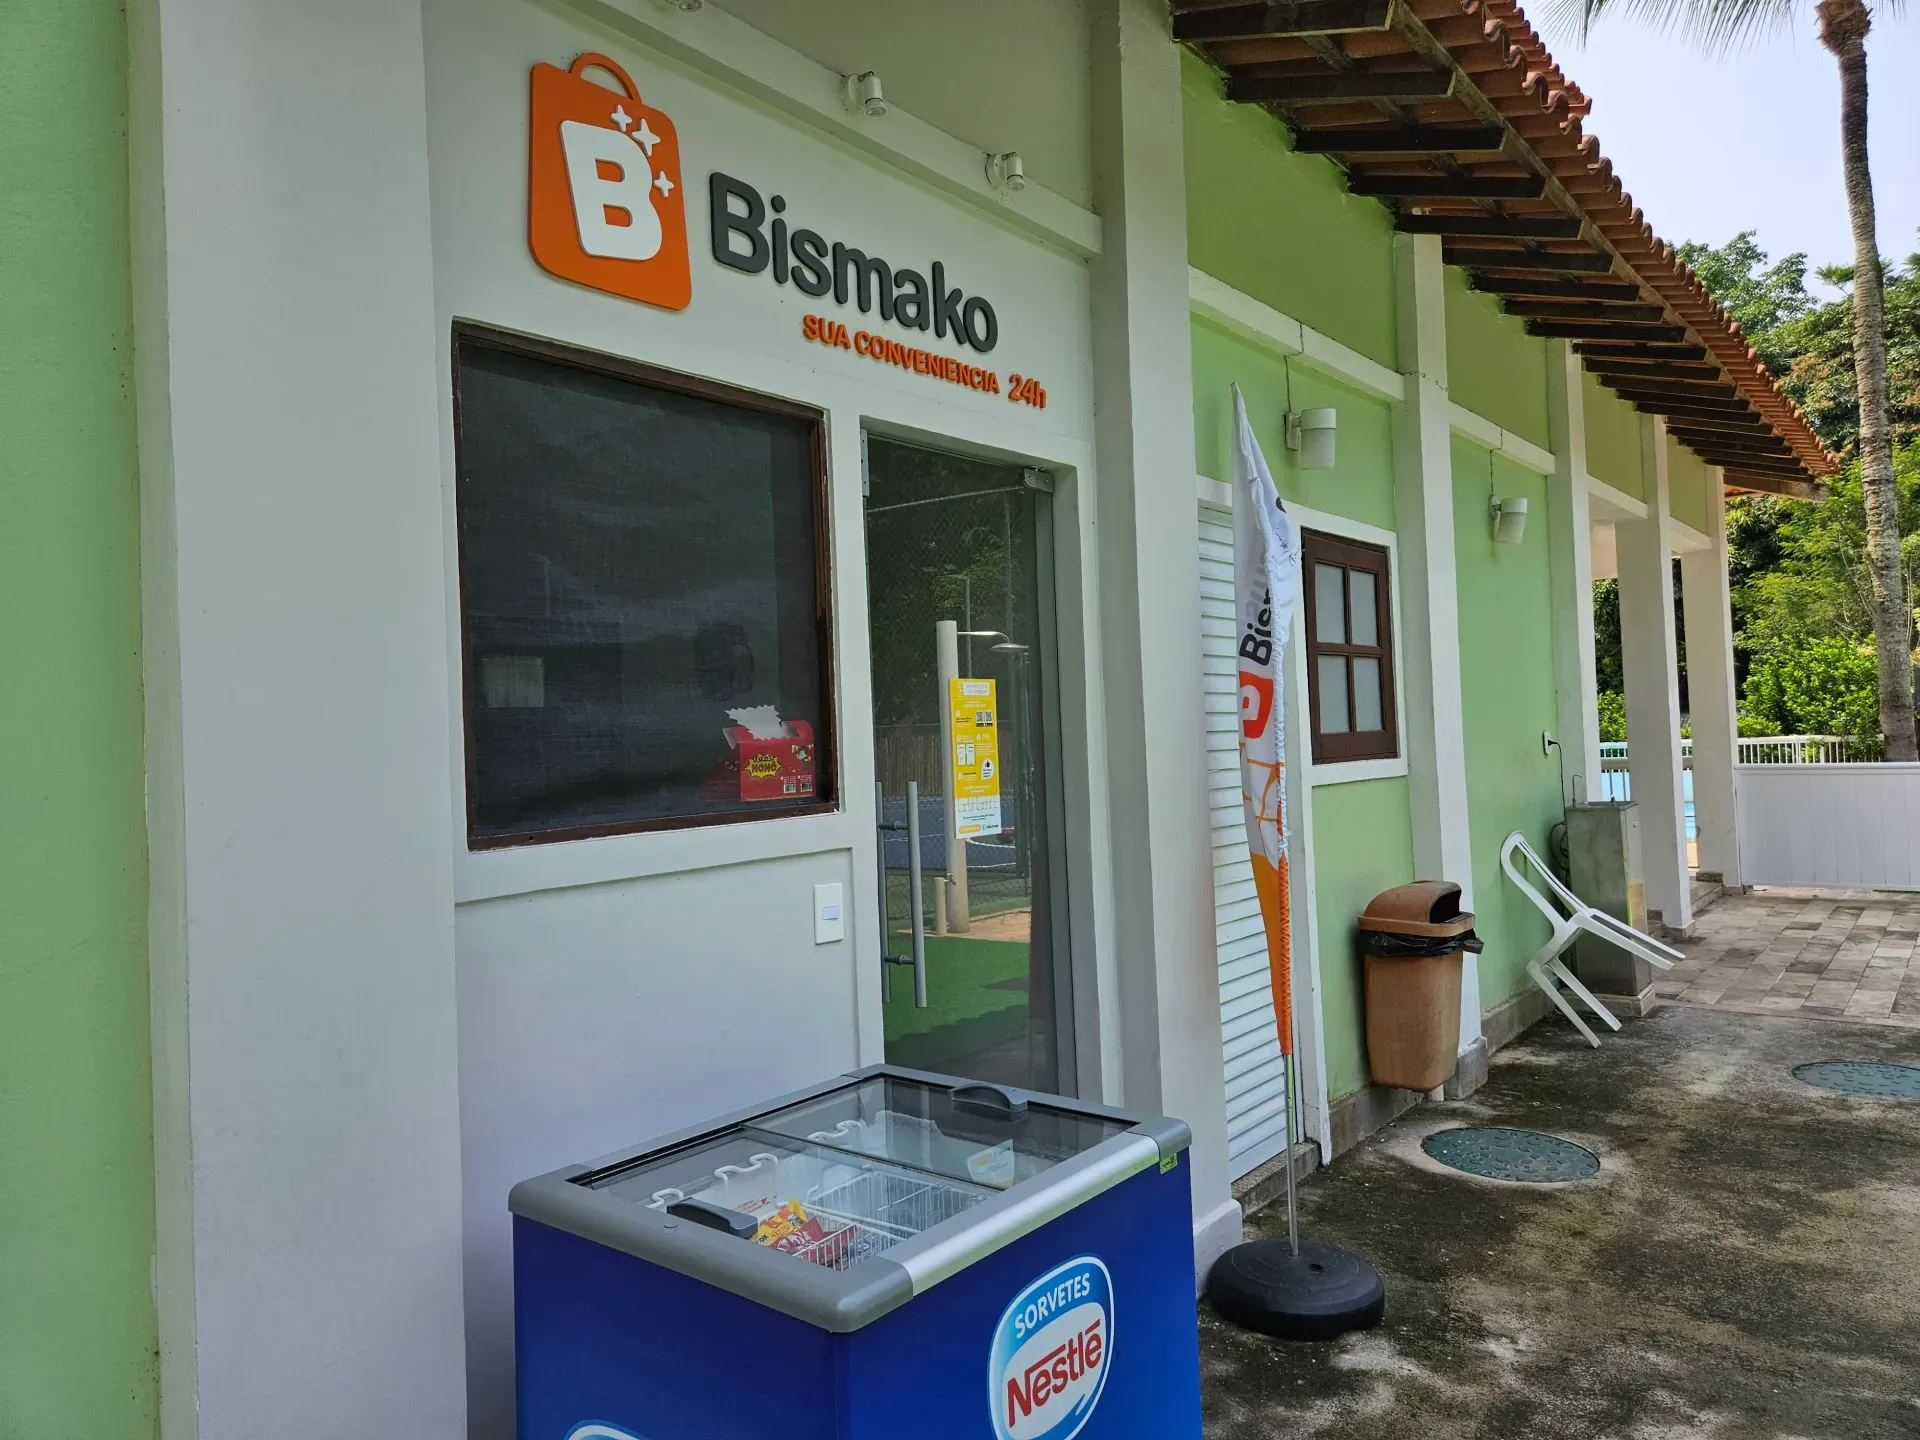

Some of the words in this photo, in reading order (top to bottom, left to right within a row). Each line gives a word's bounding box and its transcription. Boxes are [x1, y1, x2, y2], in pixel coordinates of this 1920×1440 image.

[559, 119, 663, 261] B
[709, 171, 999, 353] Bismako
[802, 314, 852, 350] SUA
[853, 331, 1000, 394] CONVENIENCIA
[1007, 373, 1047, 409] 24h
[1014, 1272, 1091, 1340] SORVETES
[1007, 1318, 1102, 1428] Nestlé
